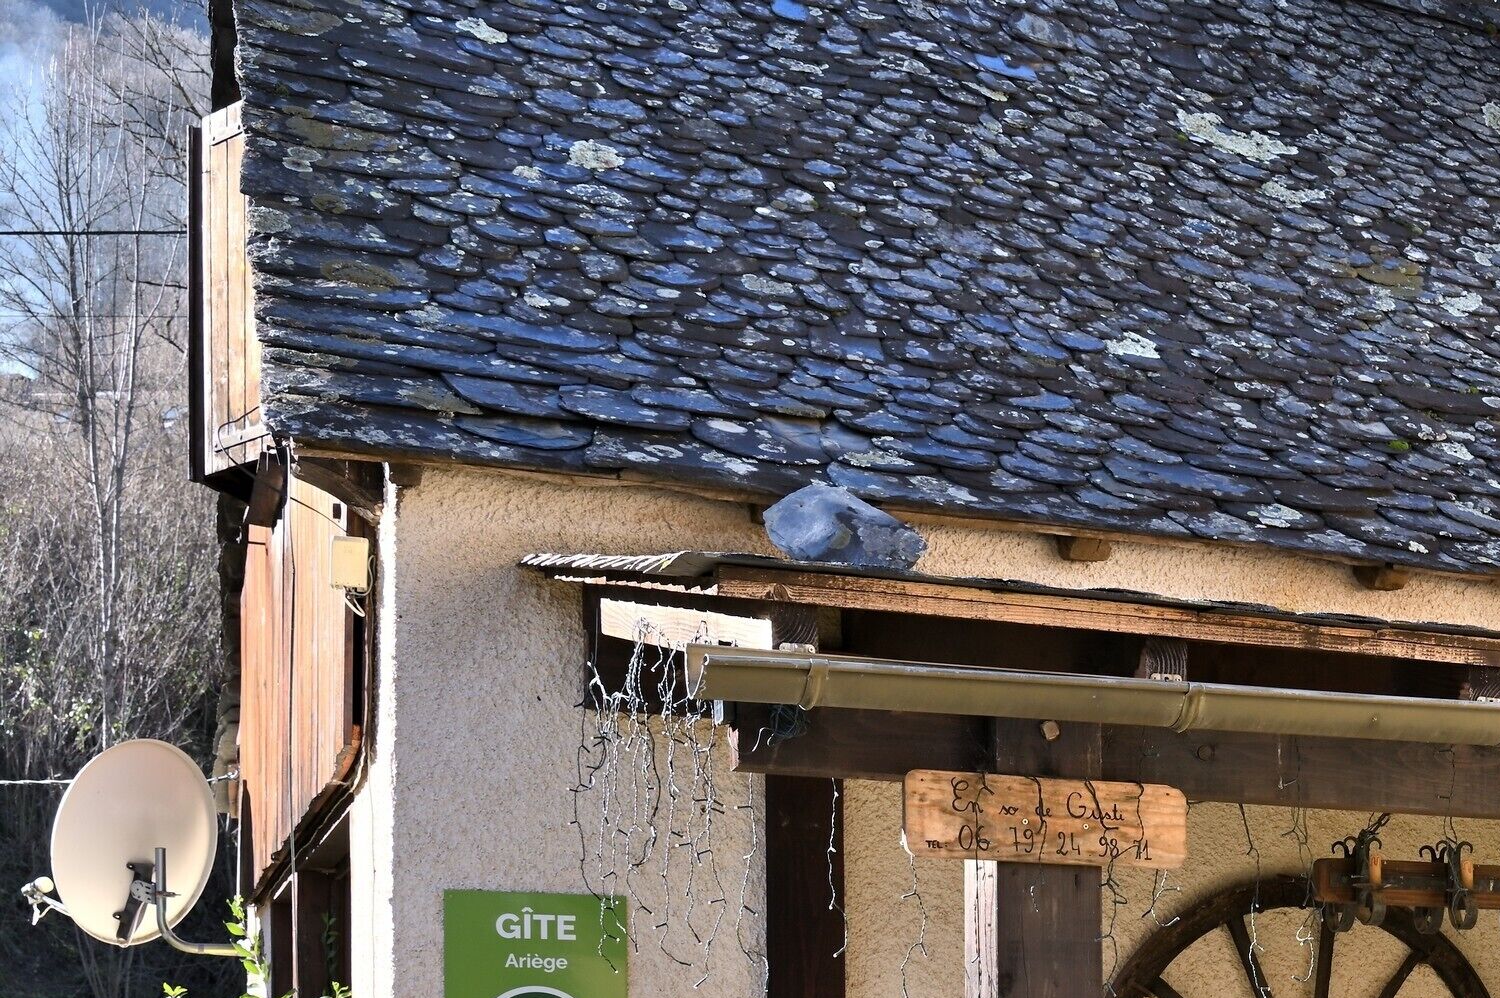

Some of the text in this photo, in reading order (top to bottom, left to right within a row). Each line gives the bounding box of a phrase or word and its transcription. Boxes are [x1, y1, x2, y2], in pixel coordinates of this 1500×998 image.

[951, 776, 983, 814] En
[495, 906, 577, 941] GÎTE
[504, 953, 568, 973] Ariège
